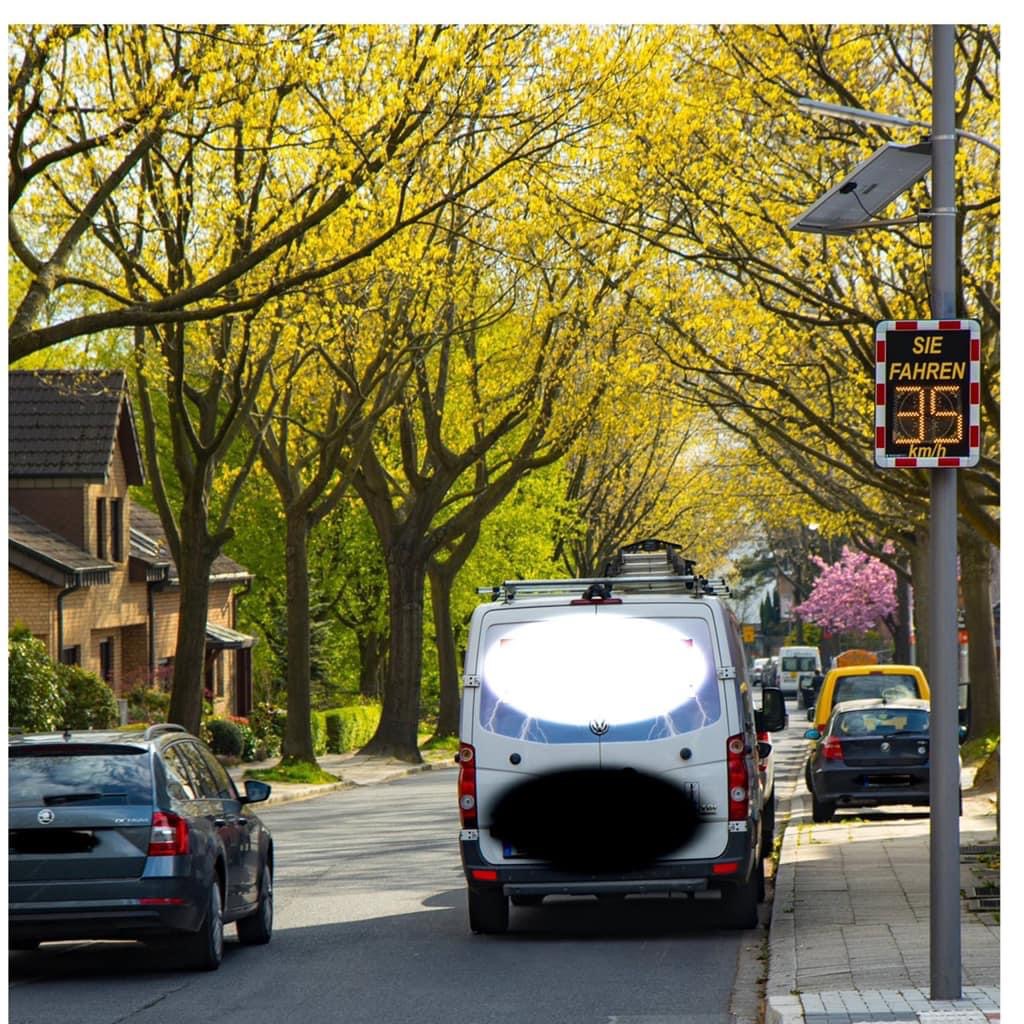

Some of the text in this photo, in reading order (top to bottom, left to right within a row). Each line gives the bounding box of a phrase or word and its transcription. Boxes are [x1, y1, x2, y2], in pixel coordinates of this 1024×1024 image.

[912, 336, 943, 354] SIE
[889, 362, 966, 380] FAHREN
[895, 386, 963, 444] 35
[908, 444, 946, 458] km/h
